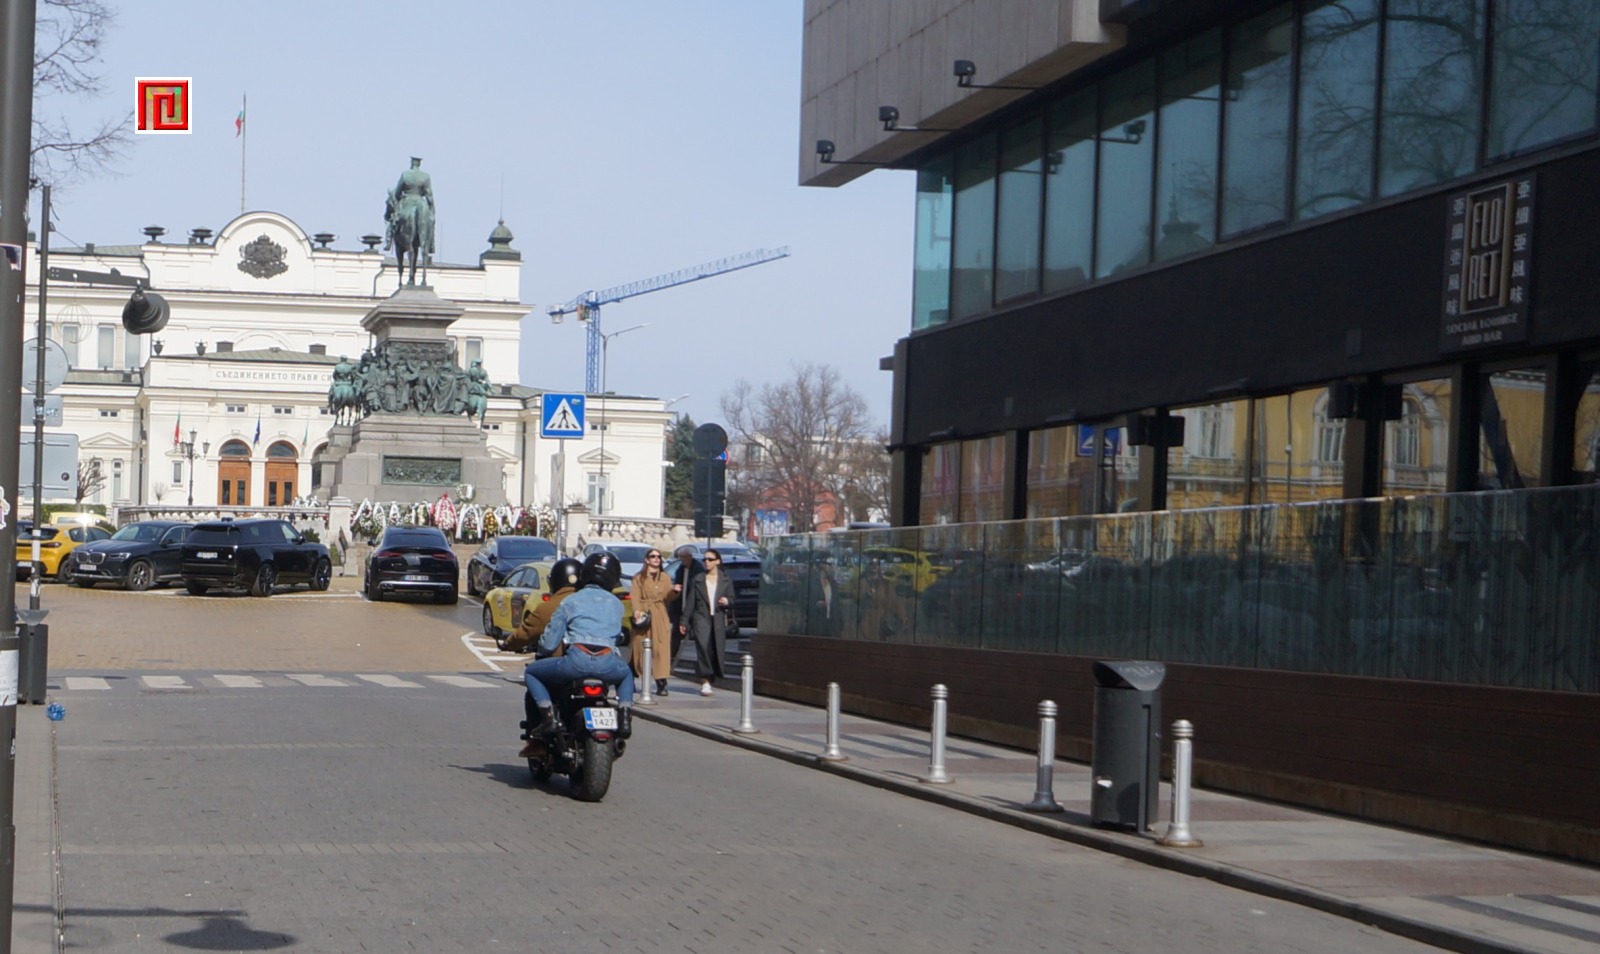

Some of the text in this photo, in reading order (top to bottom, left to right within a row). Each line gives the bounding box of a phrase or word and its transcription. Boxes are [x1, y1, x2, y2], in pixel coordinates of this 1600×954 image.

[1471, 198, 1503, 249] FLO
[1468, 250, 1500, 302] RET
[216, 371, 288, 380] СЪЕДИНЕНИЕТО
[291, 373, 318, 381] ПРАВИ
